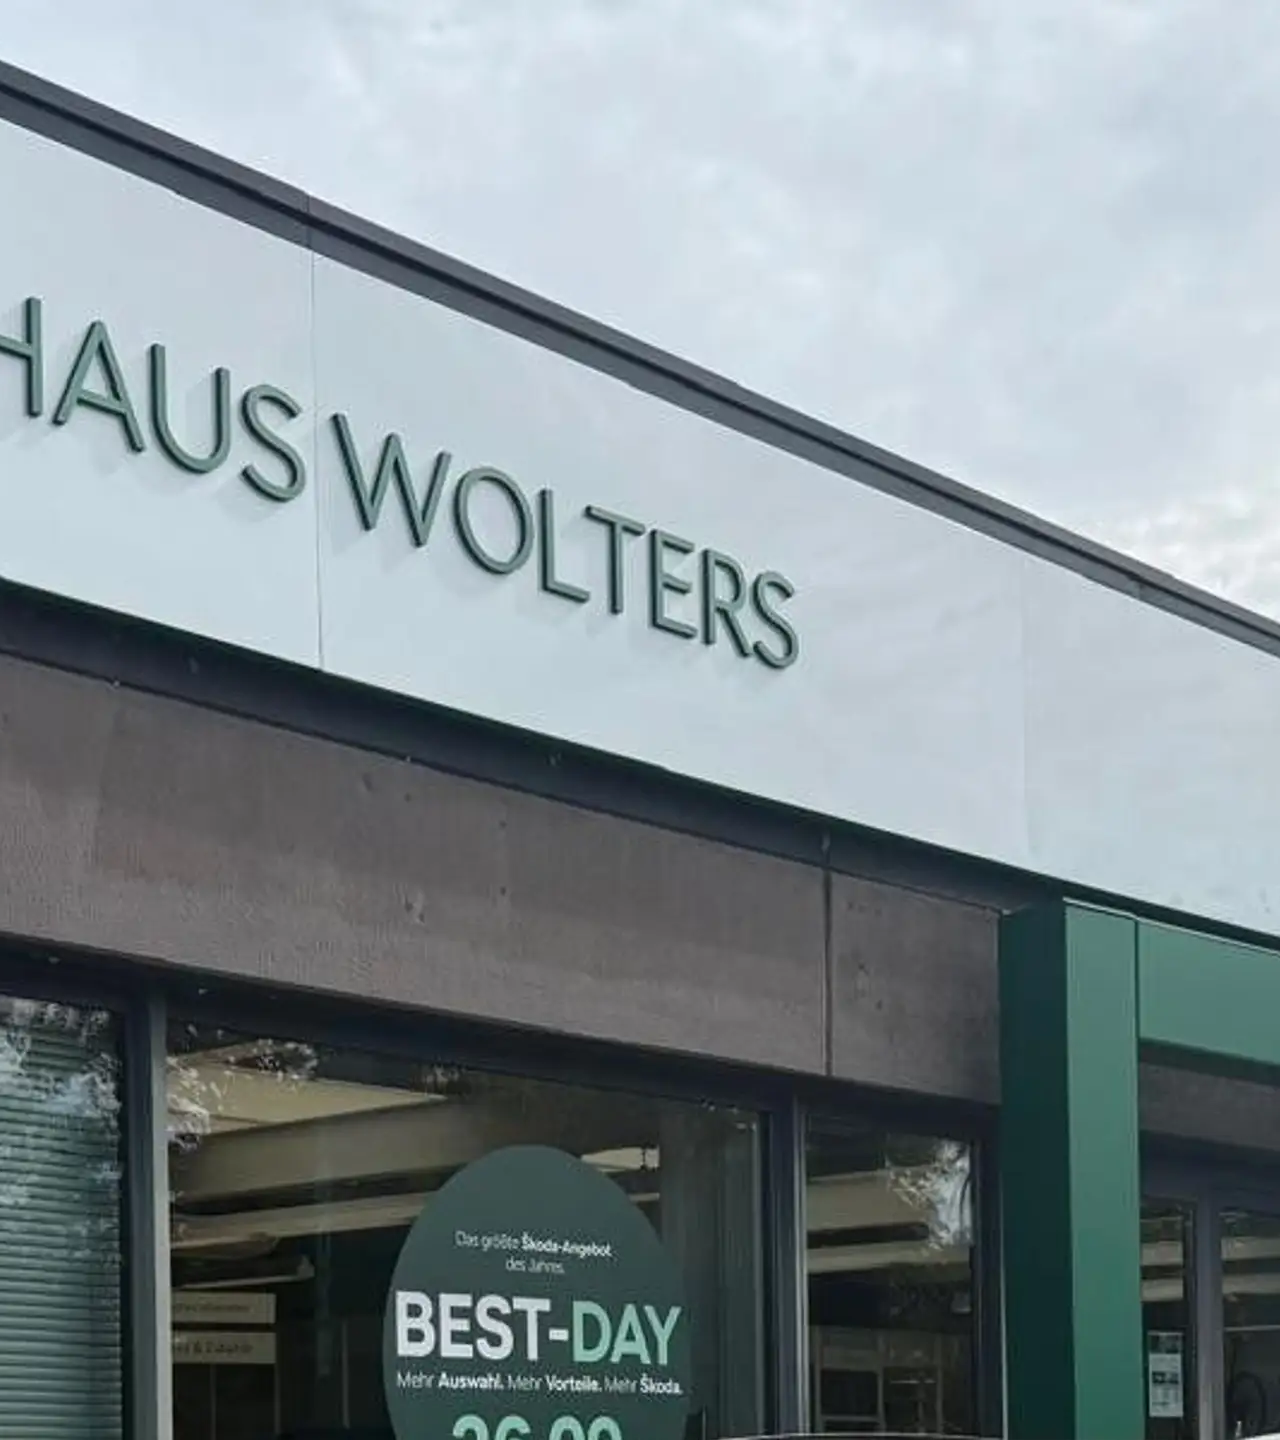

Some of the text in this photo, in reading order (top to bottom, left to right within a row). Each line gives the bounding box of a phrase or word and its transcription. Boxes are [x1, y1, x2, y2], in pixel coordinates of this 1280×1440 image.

[331, 411, 801, 670] WOLTERS
[455, 1230, 479, 1247] Das
[395, 1290, 682, 1366] BEST-DAY
[396, 1371, 684, 1396] Mehr Auswahl. Mehr Vorteile. Mehr Škoda.
